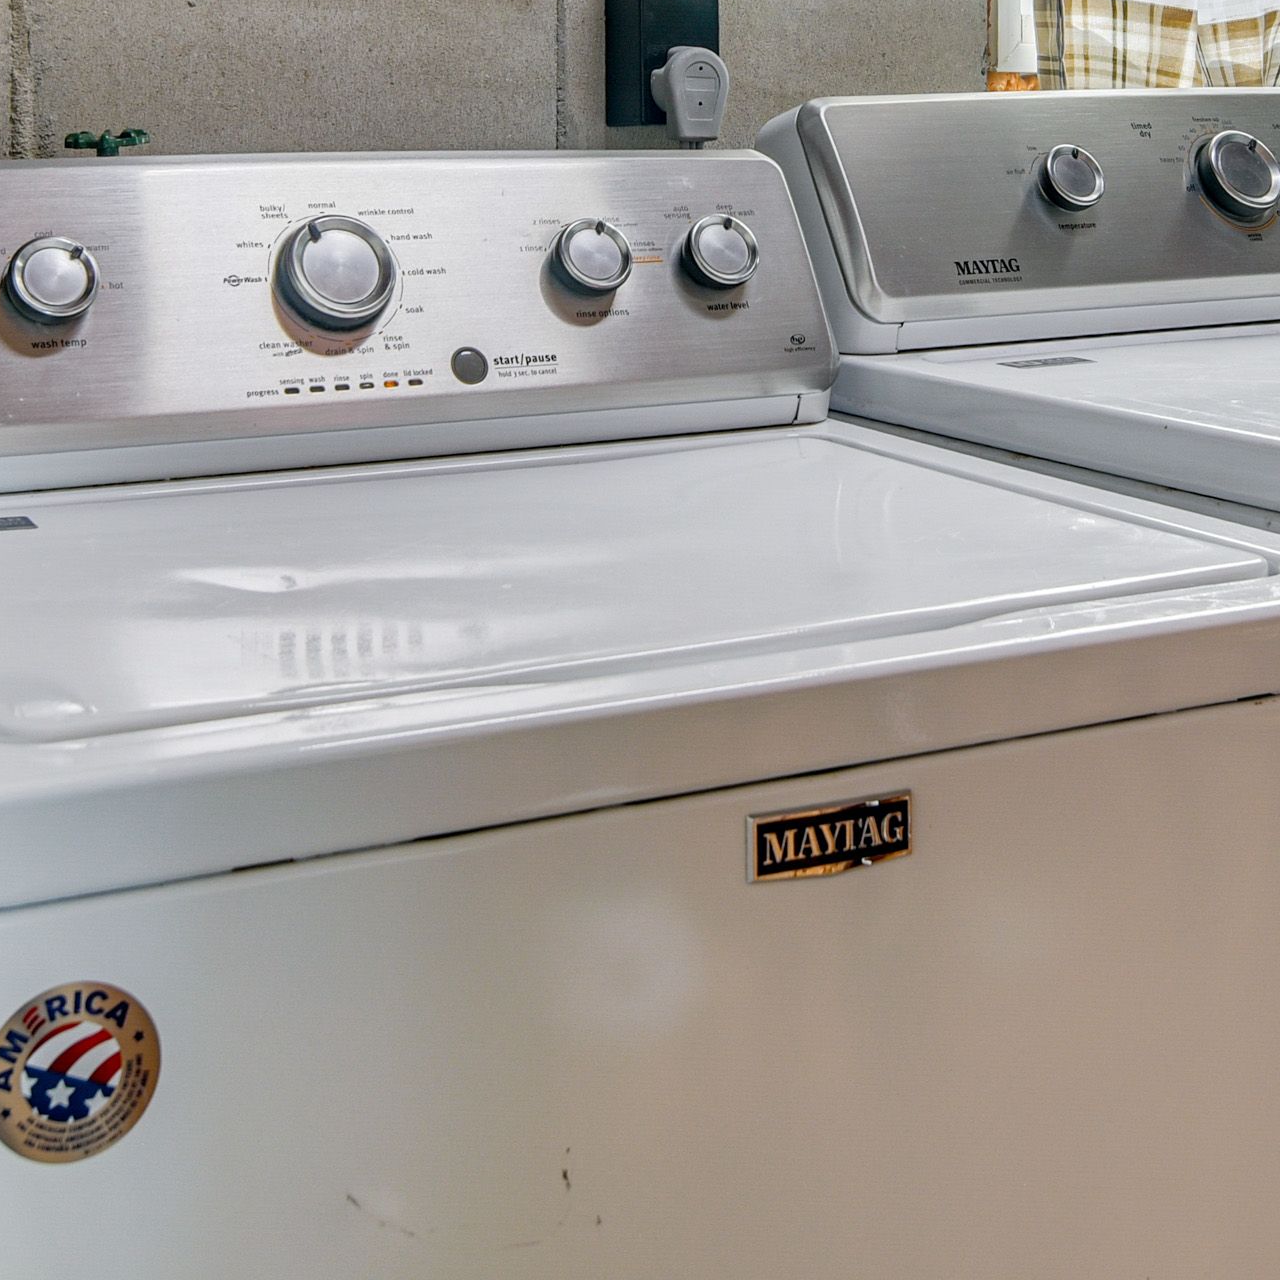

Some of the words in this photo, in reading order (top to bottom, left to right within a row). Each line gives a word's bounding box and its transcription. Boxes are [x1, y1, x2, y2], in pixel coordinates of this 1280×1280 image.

[1131, 122, 1152, 130] timed
[308, 201, 336, 209] normal
[358, 208, 385, 216] wrinkle
[387, 207, 414, 216] control
[1058, 222, 1096, 231] temperature
[390, 233, 411, 241] hand
[413, 232, 433, 240] wash
[236, 241, 264, 249] whites
[407, 268, 424, 276] cold
[426, 267, 447, 275] wash
[954, 258, 1020, 276] MAYTAG
[405, 305, 425, 313] soak
[706, 303, 729, 311] water
[730, 300, 750, 310] level
[575, 310, 597, 318] rinse
[598, 308, 630, 319] options
[383, 334, 403, 342] rinse
[31, 339, 58, 349] wash
[61, 338, 87, 349] temp
[259, 341, 281, 350] clean
[283, 339, 313, 349] washer
[392, 342, 410, 351] spin
[325, 347, 347, 356] drain
[357, 346, 375, 356] spin
[493, 353, 558, 366] start/pause
[359, 372, 374, 381] spin
[383, 370, 399, 378] done
[403, 369, 411, 377] lid
[412, 368, 433, 376] locked
[279, 377, 305, 386] sensing
[308, 375, 326, 383] wash
[333, 374, 350, 382] rinse
[246, 388, 279, 398] progress
[762, 811, 904, 866] MAYTAG
